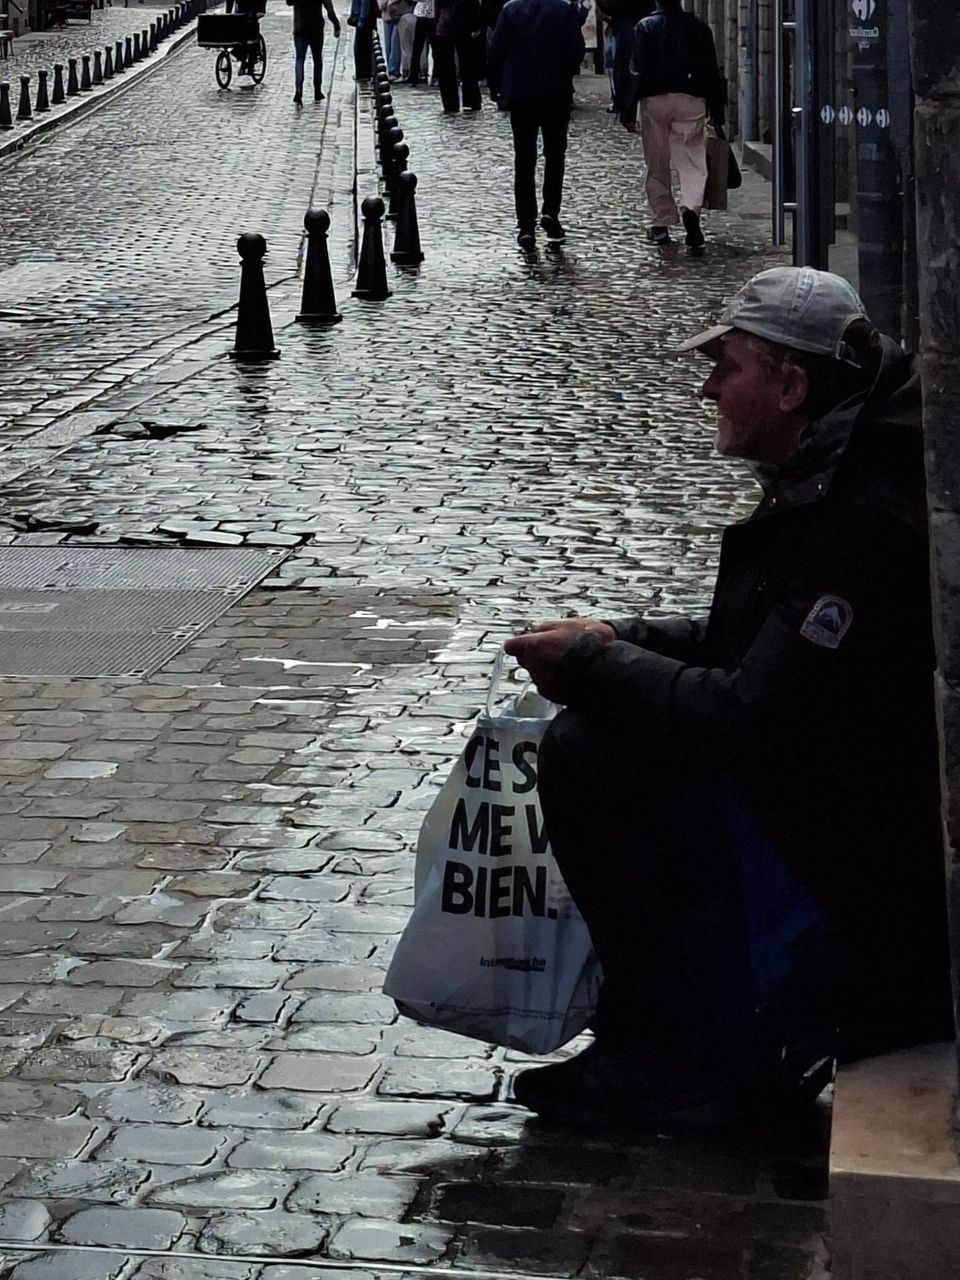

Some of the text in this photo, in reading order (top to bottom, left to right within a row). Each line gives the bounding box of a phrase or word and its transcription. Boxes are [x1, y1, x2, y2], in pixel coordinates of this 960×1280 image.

[512, 741, 540, 794] S
[448, 798, 515, 857] ME
[440, 860, 558, 920] BIEN.
